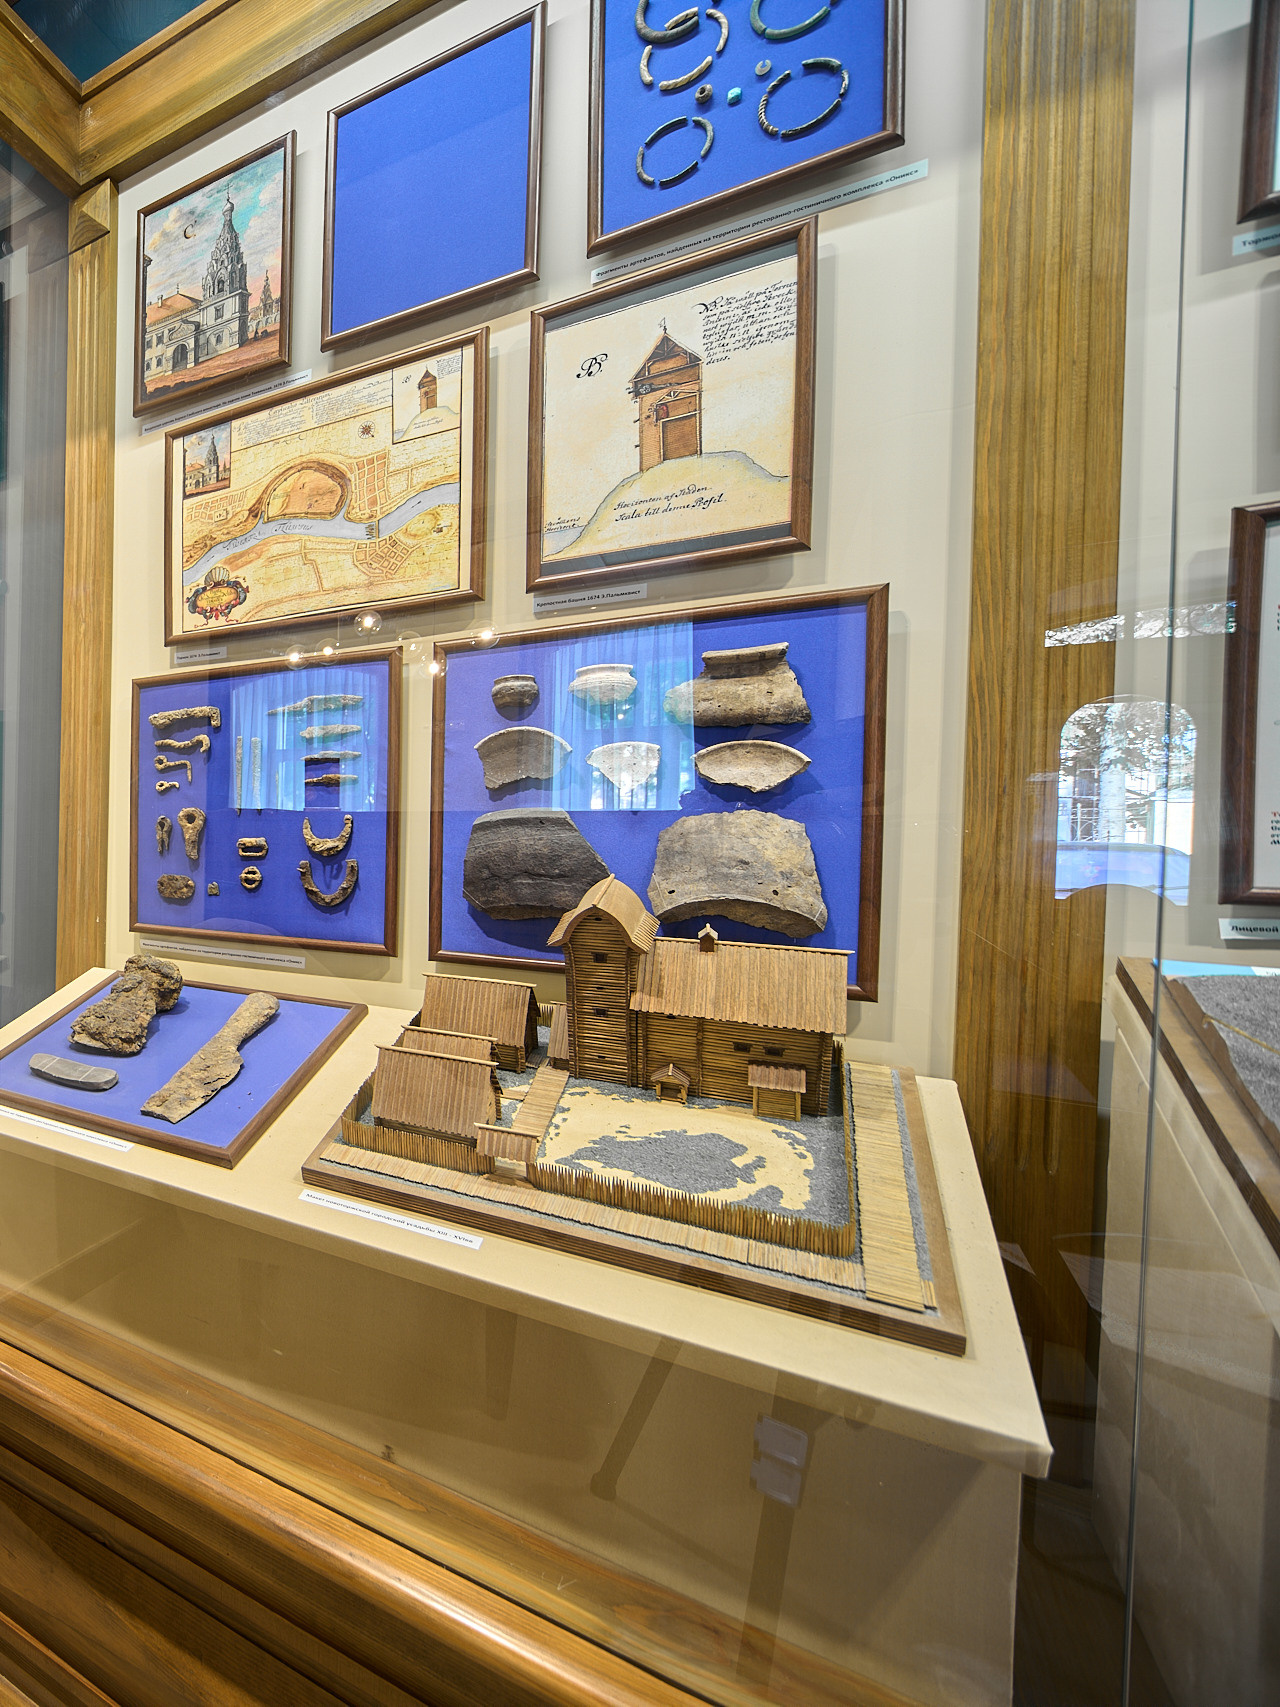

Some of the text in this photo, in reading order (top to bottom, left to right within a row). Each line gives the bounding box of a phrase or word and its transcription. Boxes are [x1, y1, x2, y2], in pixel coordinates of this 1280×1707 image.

[596, 263, 629, 277] Фрагменты
[630, 252, 666, 267] артефактов,
[666, 240, 702, 255] найденных
[712, 223, 751, 240] территории
[842, 180, 884, 198] комплекса
[885, 169, 919, 184] «Оникс»
[1231, 924, 1279, 935] Лицевой
[306, 1193, 325, 1202] Макет
